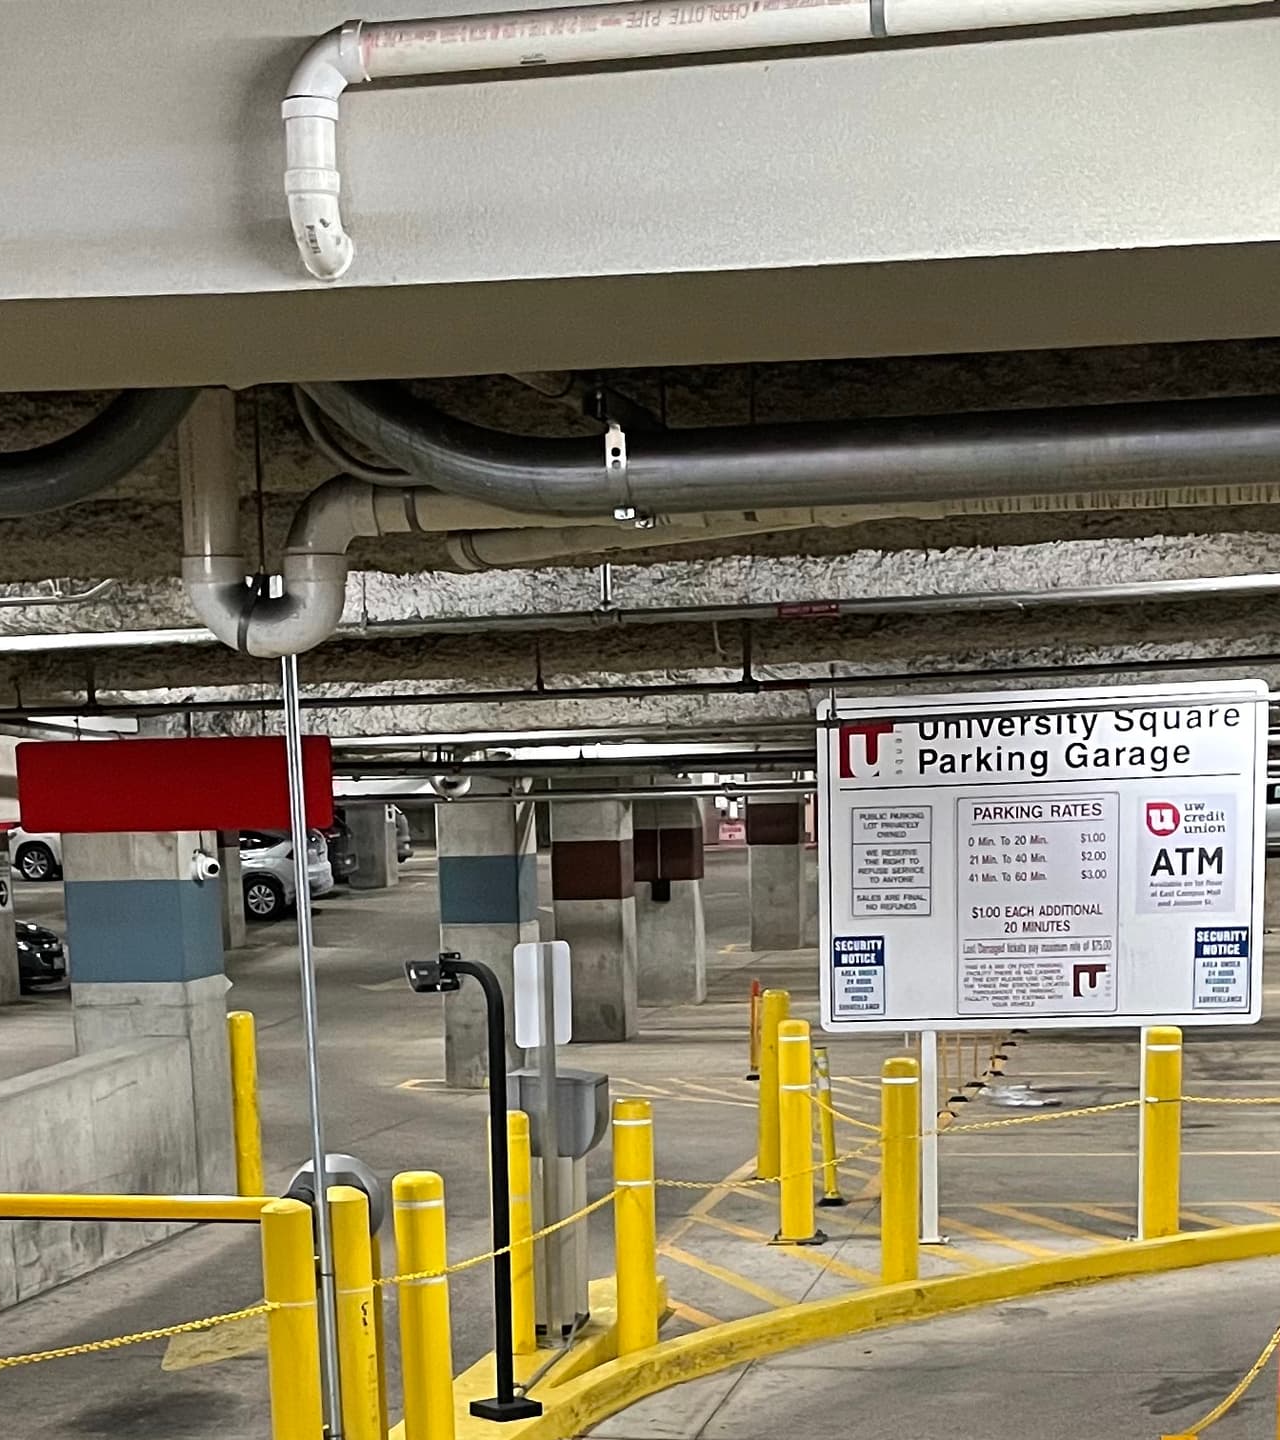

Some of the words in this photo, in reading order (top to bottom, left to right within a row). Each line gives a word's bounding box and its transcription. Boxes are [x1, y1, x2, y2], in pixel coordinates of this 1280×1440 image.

[919, 713, 1097, 740] University
[1114, 707, 1240, 737] Square
[919, 746, 1048, 777] Parking
[1065, 743, 1190, 772] Garage
[973, 805, 1043, 821] PARKING
[1051, 802, 1102, 817] RATES
[1185, 803, 1205, 811] uw
[1184, 811, 1225, 822] credit
[1184, 823, 1226, 834] union
[968, 836, 975, 848] 0
[1000, 835, 1011, 846] To
[1014, 835, 1027, 846] 20
[1080, 832, 1106, 844] $1.00
[969, 855, 979, 865] 21
[1002, 854, 1011, 864] To
[1015, 853, 1027, 863] 40
[1081, 851, 1106, 862] $2.00
[1150, 846, 1223, 877] ATM
[969, 873, 979, 882] 41
[1002, 872, 1011, 882] To
[1015, 871, 1027, 882] 60
[1081, 869, 1107, 880] $3.00
[972, 906, 1000, 919] $1.00
[1005, 905, 1034, 918] EACH
[1039, 904, 1103, 916] ADDITIONAL
[1004, 921, 1017, 933] 20
[1022, 920, 1071, 933] MINUTES
[1197, 930, 1247, 943] SECURITY
[835, 940, 882, 952] SECURITY
[1203, 944, 1240, 955] NOTICE
[841, 953, 876, 964] NOTICE
